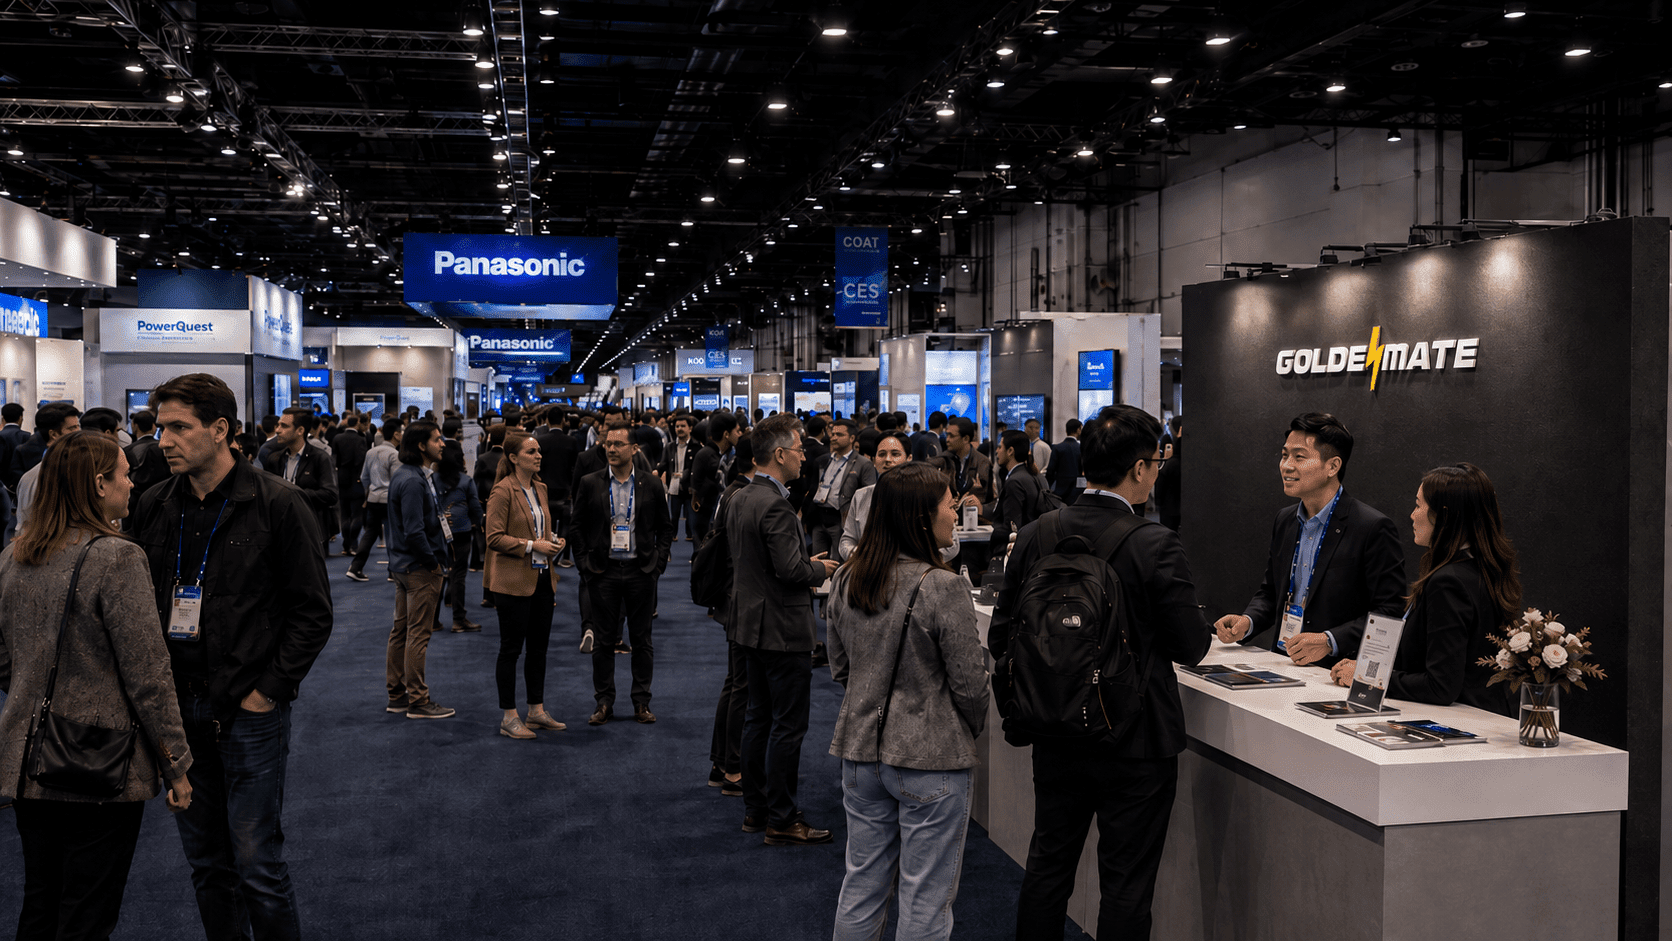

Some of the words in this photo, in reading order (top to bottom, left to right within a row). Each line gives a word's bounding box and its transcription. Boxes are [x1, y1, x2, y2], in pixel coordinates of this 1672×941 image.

[843, 236, 880, 248] COAT
[434, 250, 586, 277] Panasonic
[844, 283, 879, 299] CES
[137, 320, 214, 333] PowerQuest
[470, 335, 554, 350] Panasonic
